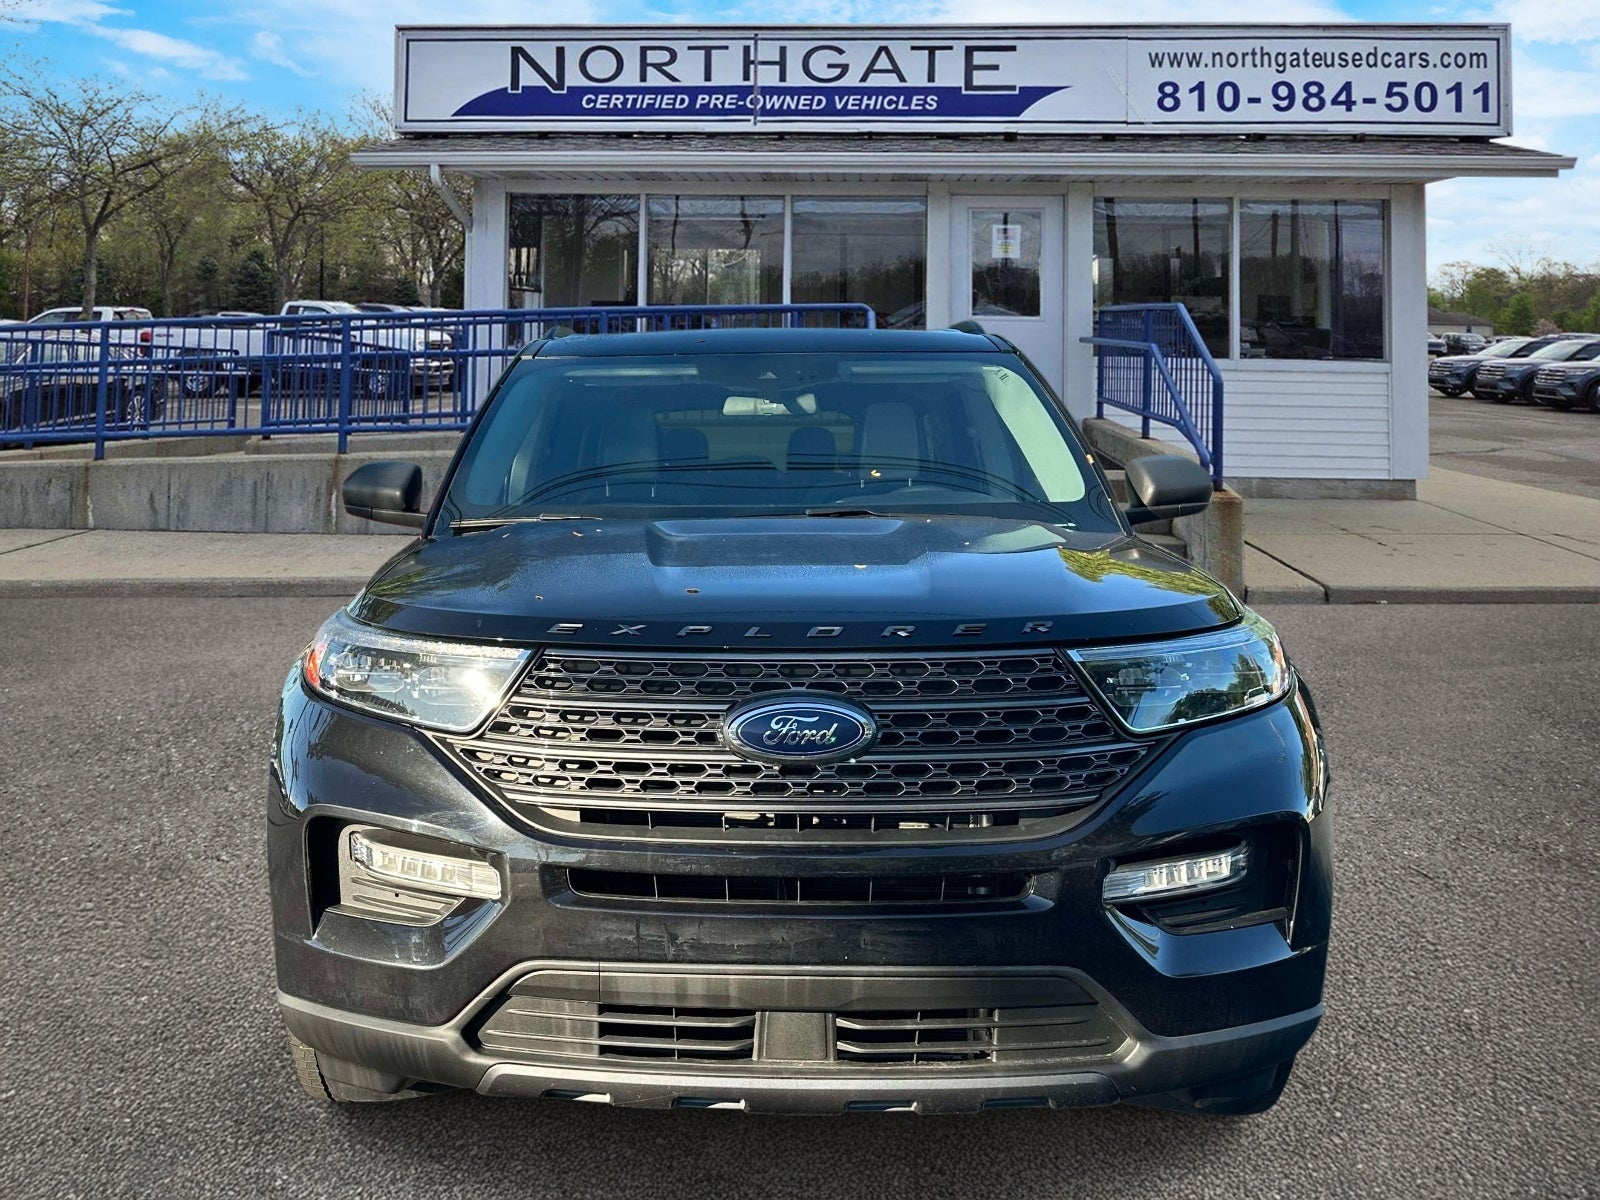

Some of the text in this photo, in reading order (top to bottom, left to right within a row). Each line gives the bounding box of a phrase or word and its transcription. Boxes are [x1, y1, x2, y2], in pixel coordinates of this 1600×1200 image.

[510, 45, 1017, 92] NORTHGATE
[1148, 46, 1488, 73] www.northgateusedcars.com
[581, 94, 938, 111] CERTIFIED PRE-OWNED VEHICLES
[1156, 80, 1490, 113] 810-984-5011
[547, 620, 1054, 638] EXPLORER
[763, 714, 838, 746] Ford
